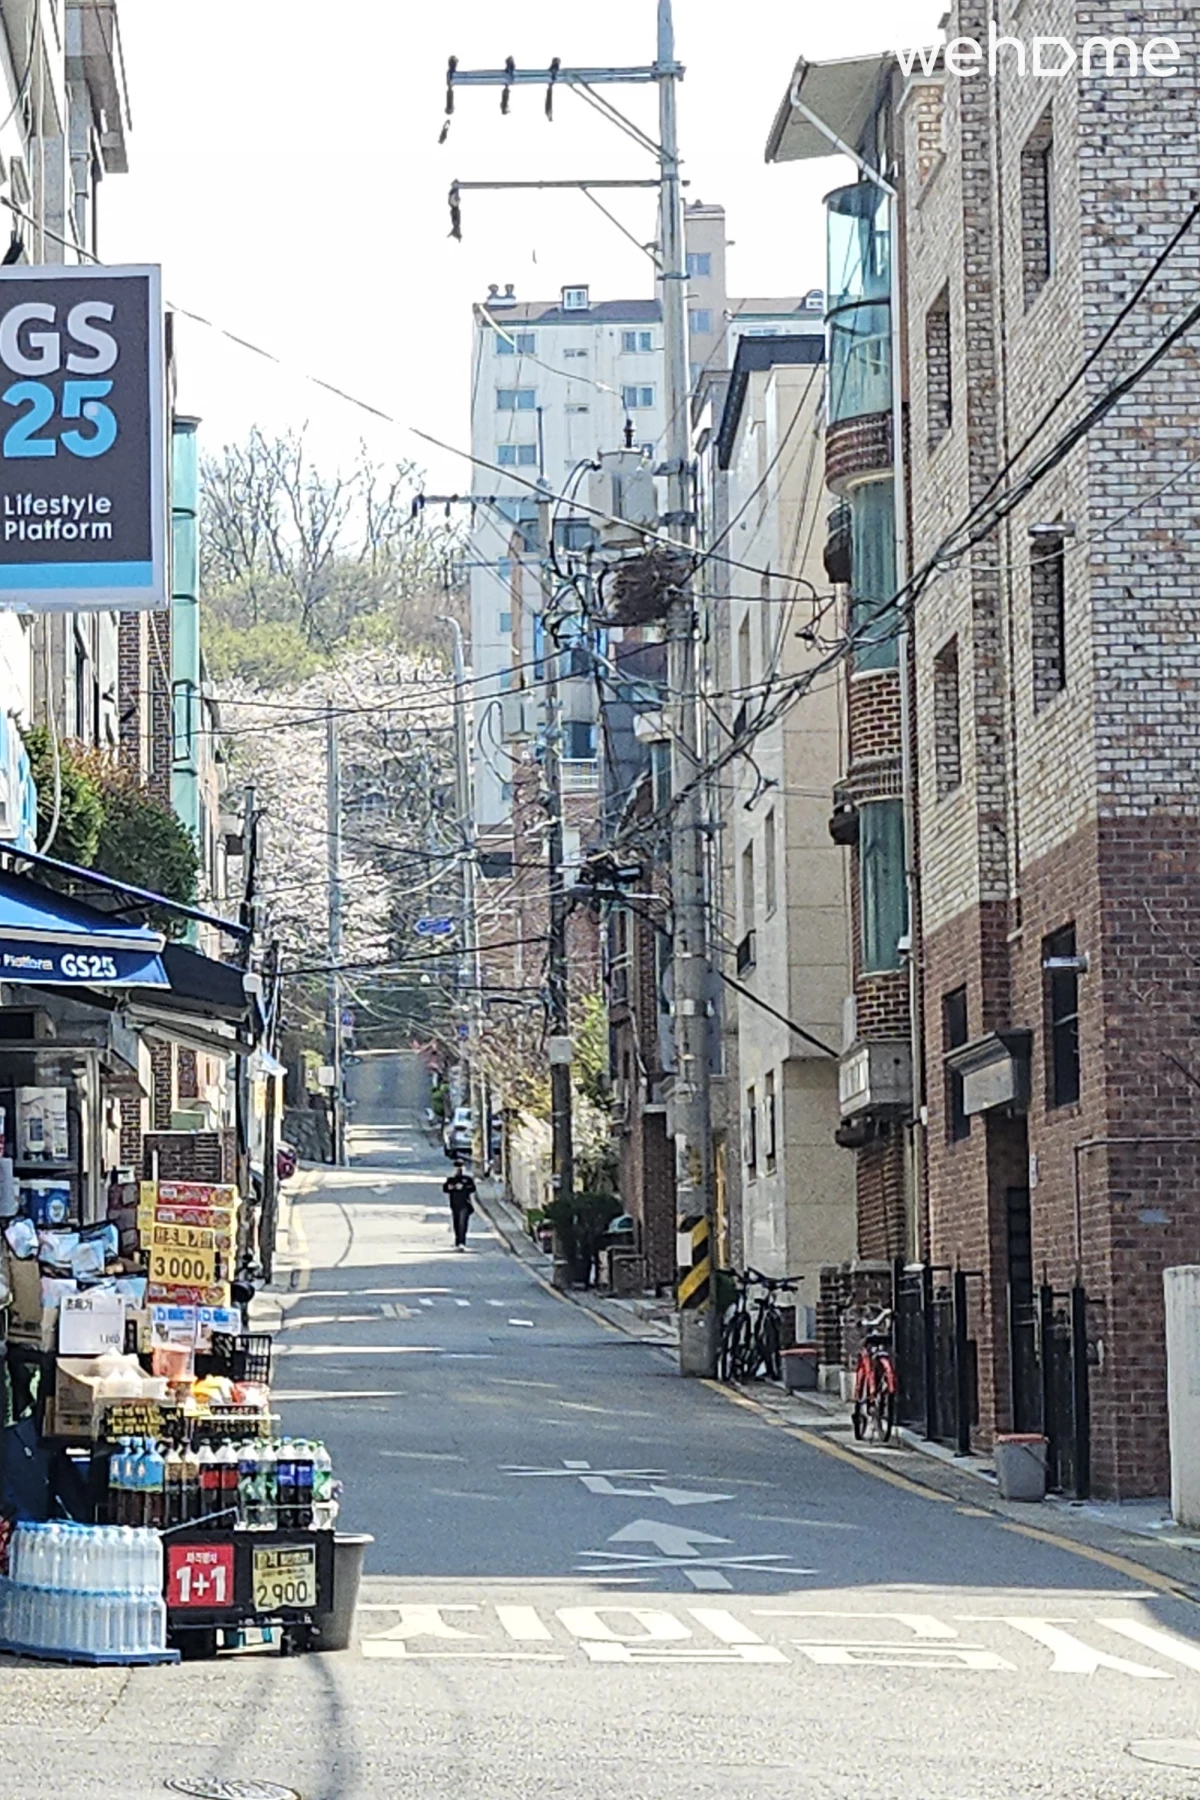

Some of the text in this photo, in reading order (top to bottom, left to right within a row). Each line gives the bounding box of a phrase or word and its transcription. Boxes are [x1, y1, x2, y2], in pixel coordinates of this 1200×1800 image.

[1, 380, 118, 458] 25
[3, 493, 113, 520] Lifestyle
[4, 519, 113, 541] Platform
[3, 953, 54, 971] Platform
[60, 952, 118, 978] GS25
[176, 1566, 227, 1603] 1+1
